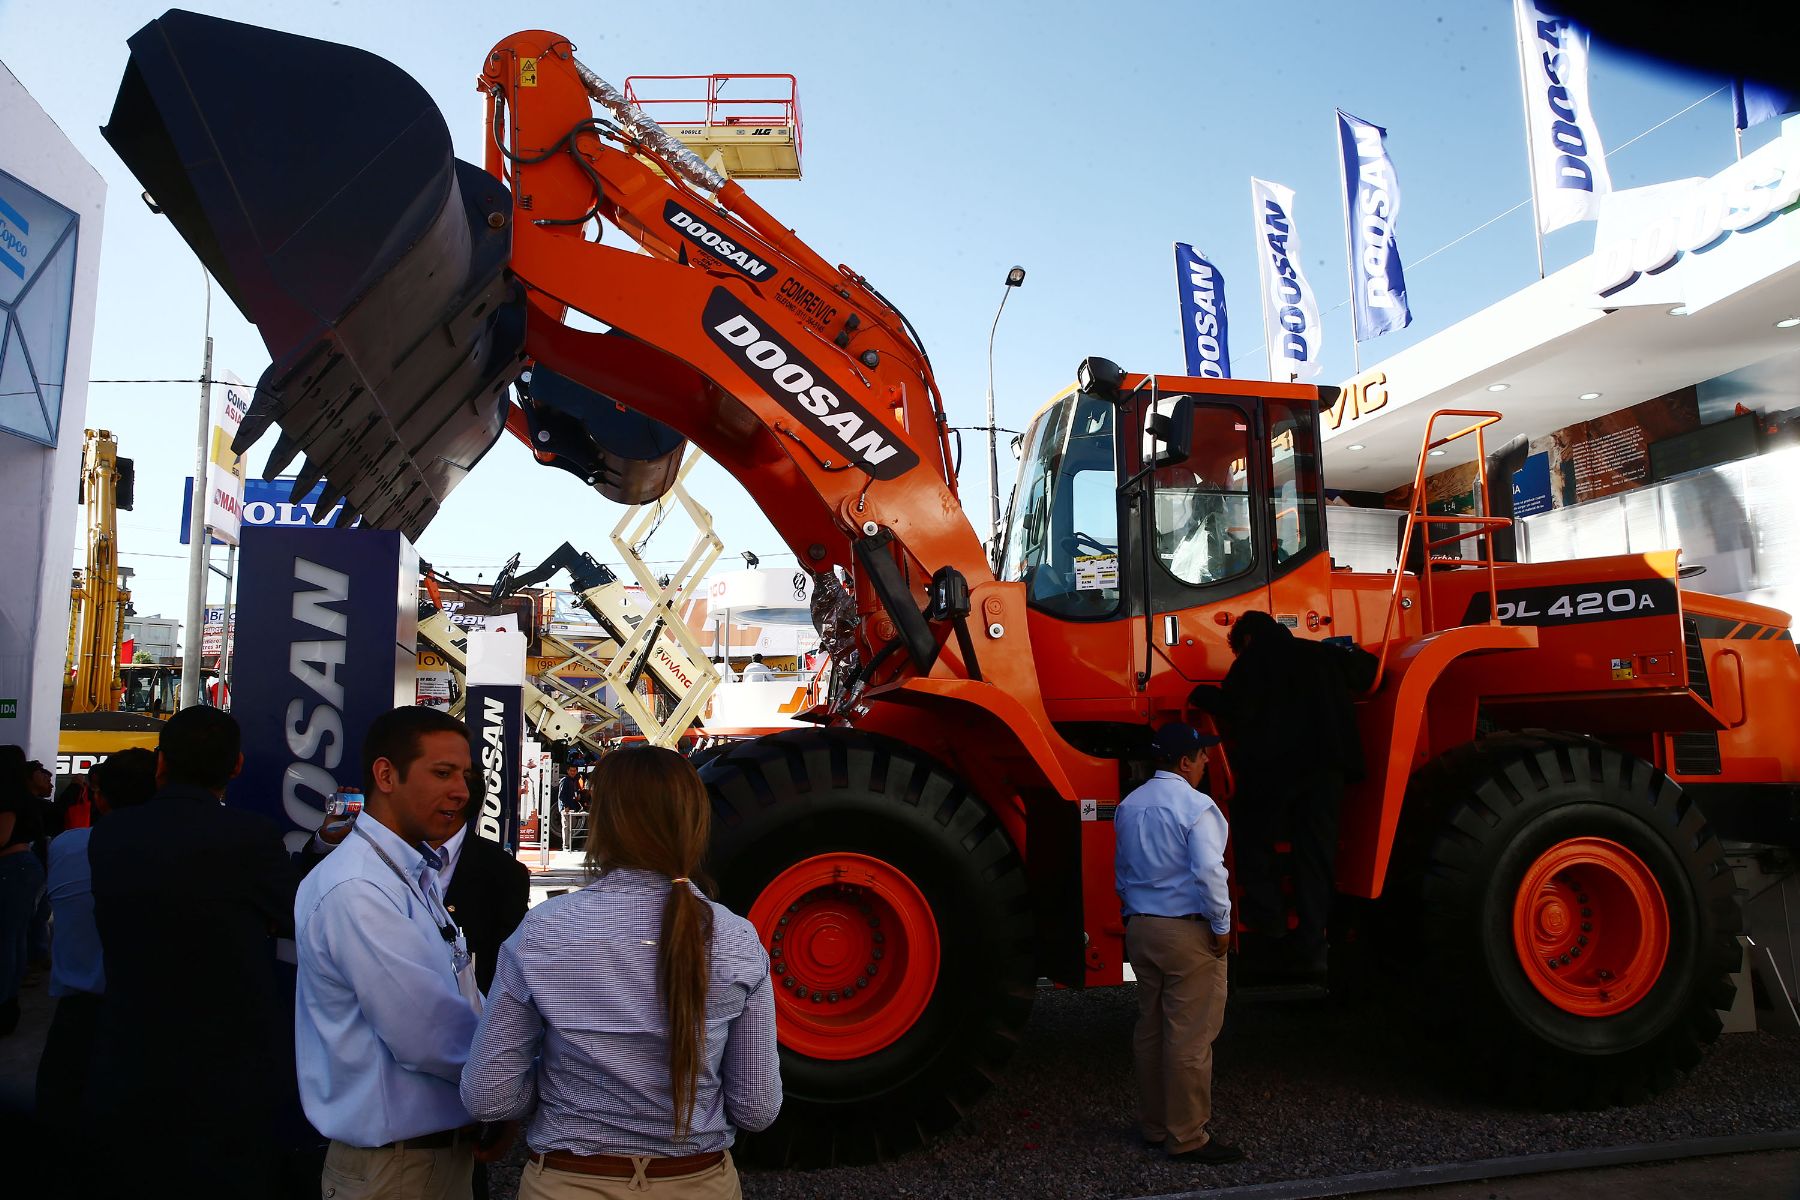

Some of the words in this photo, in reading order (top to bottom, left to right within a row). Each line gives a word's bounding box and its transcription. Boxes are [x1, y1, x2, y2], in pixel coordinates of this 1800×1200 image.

[751, 128, 772, 136] JLG
[1533, 0, 1594, 193] DOOSA
[669, 211, 767, 278] DOOSAN
[1265, 199, 1308, 362] DOOSAN
[1354, 126, 1393, 309] DOOSAN
[780, 277, 838, 325] COMREIVIC
[714, 314, 899, 466] DOOSAN
[242, 501, 363, 529] OLV
[479, 696, 505, 844] DOOSAN
